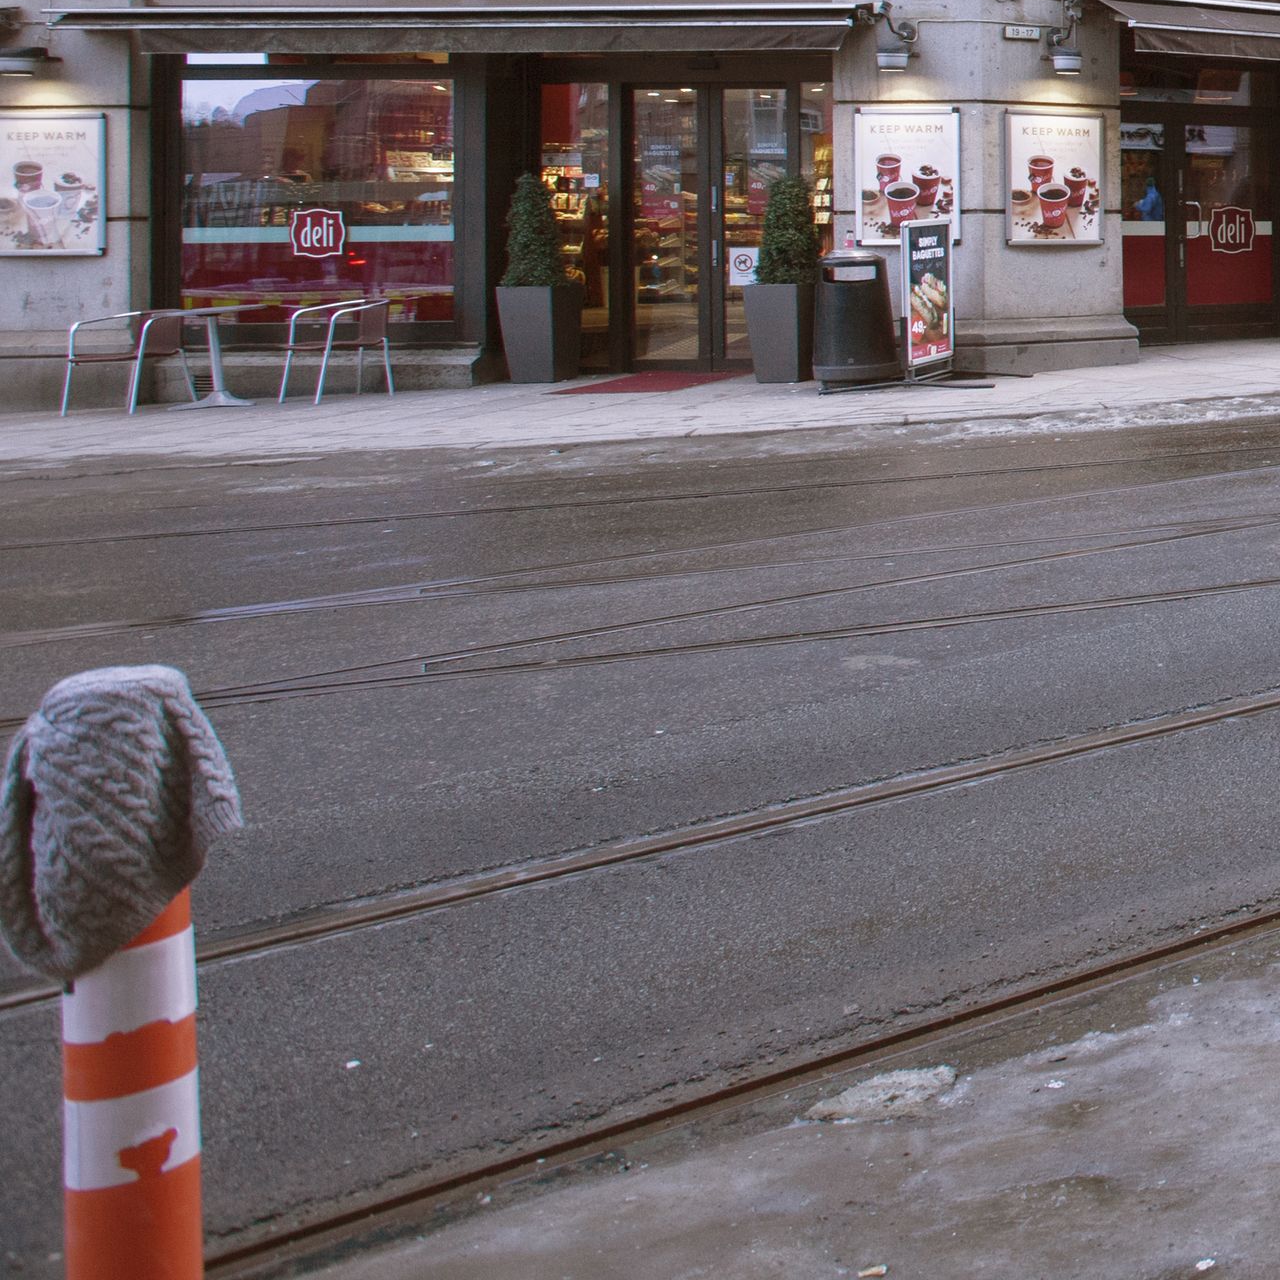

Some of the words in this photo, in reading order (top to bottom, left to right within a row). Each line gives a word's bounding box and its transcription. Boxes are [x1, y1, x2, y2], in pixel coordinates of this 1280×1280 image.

[869, 124, 900, 134] KEEP
[904, 124, 944, 133] WARM
[1022, 126, 1053, 136] KEEP
[1057, 127, 1091, 137] WARM
[6, 131, 40, 141] KEEP
[43, 131, 87, 141] WARM
[301, 216, 334, 247] deli
[1217, 214, 1246, 244] deli
[918, 235, 938, 248] SIMPLY
[912, 247, 945, 260] BAGUETTES
